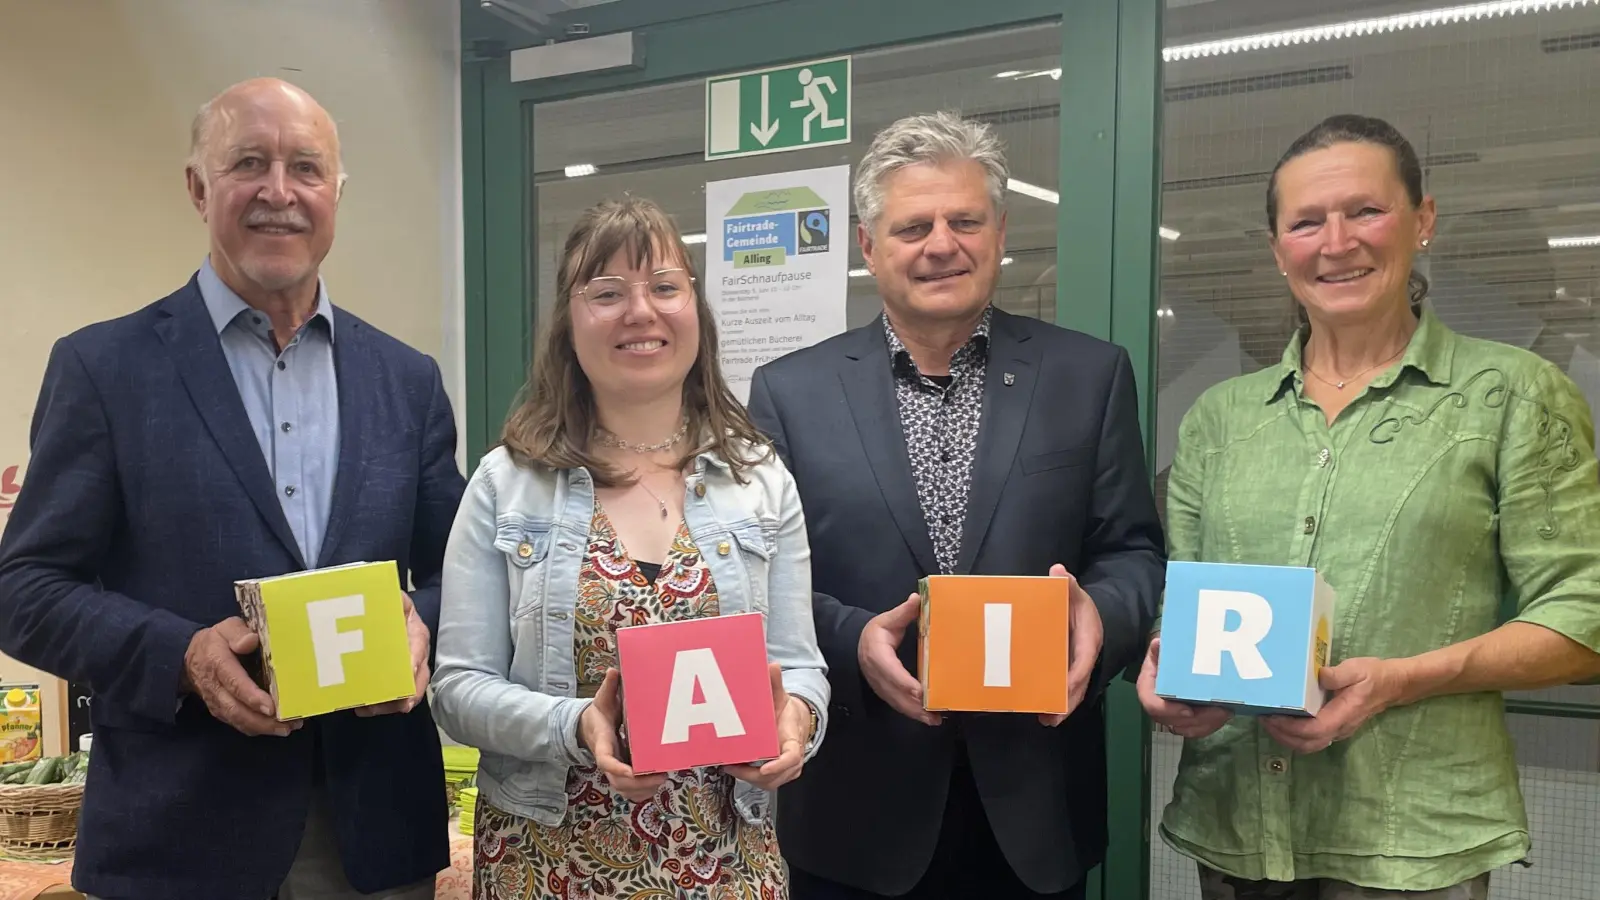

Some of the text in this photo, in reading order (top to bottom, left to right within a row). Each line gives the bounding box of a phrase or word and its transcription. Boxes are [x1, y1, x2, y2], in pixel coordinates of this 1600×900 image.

[726, 220, 778, 234] Fairtrade-
[726, 234, 778, 248] Gemeinde
[743, 253, 771, 264] Alling
[722, 272, 812, 286] FairSchnaufpause
[744, 316, 772, 325] Auszeit
[794, 314, 816, 323] Alltag
[306, 593, 365, 688] F
[1192, 589, 1272, 680] R
[983, 603, 1012, 687] I
[661, 648, 746, 744] A
